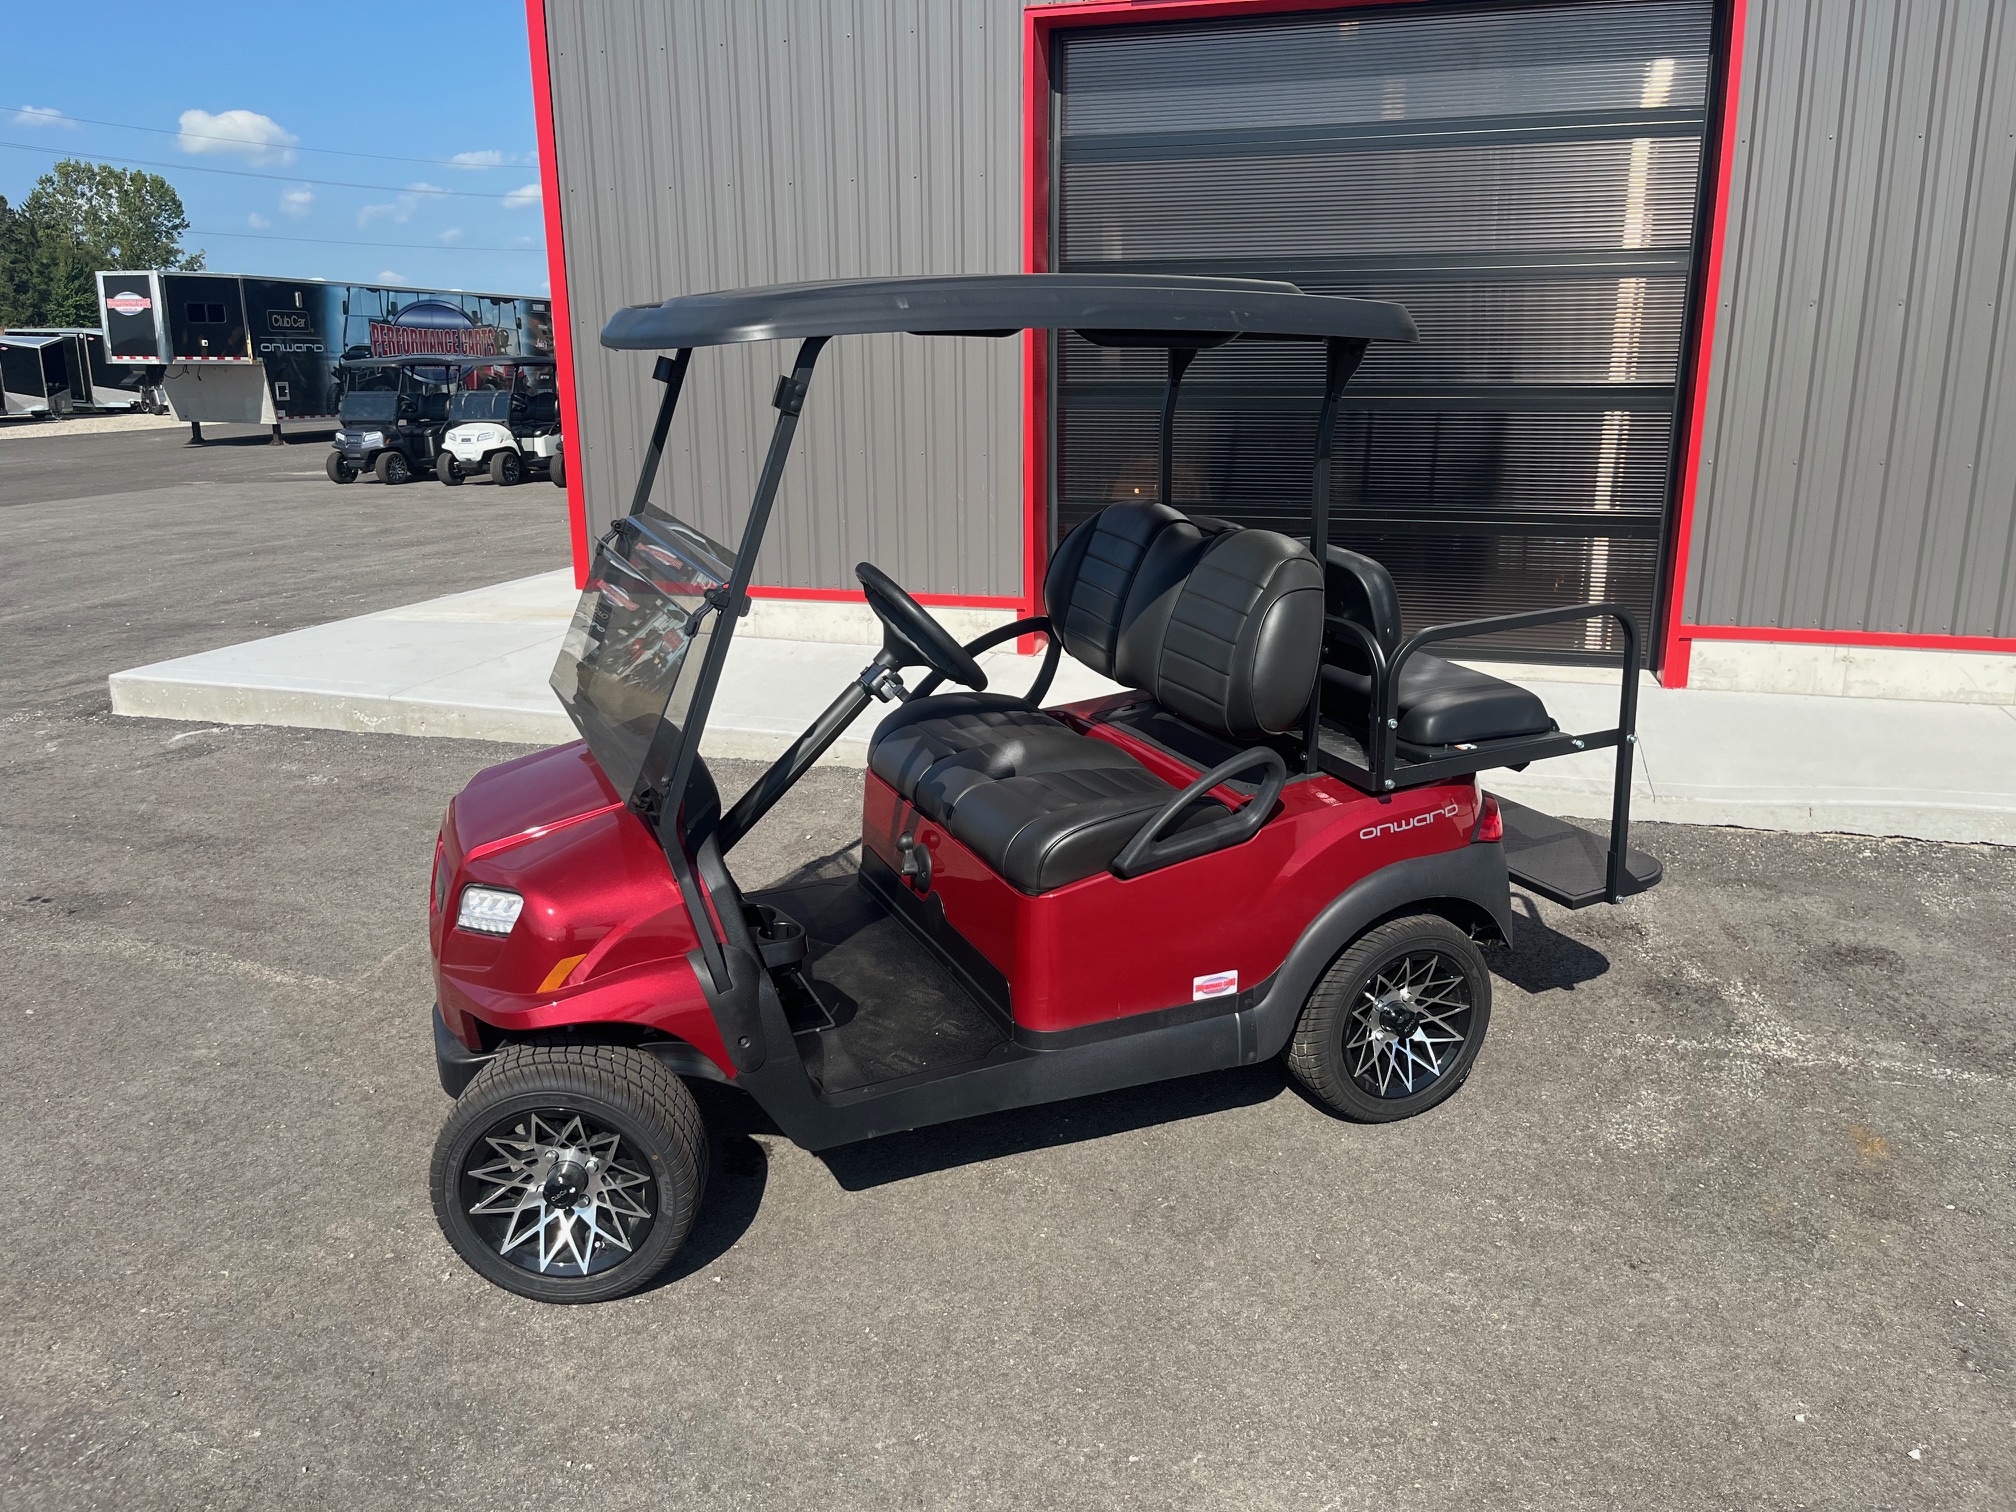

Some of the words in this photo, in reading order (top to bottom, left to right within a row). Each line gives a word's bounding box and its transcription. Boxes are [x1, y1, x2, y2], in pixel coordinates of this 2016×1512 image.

[272, 314, 291, 327] Club
[291, 315, 306, 328] Car
[370, 321, 461, 359] PERFORMANCE
[460, 326, 497, 358] CARTS
